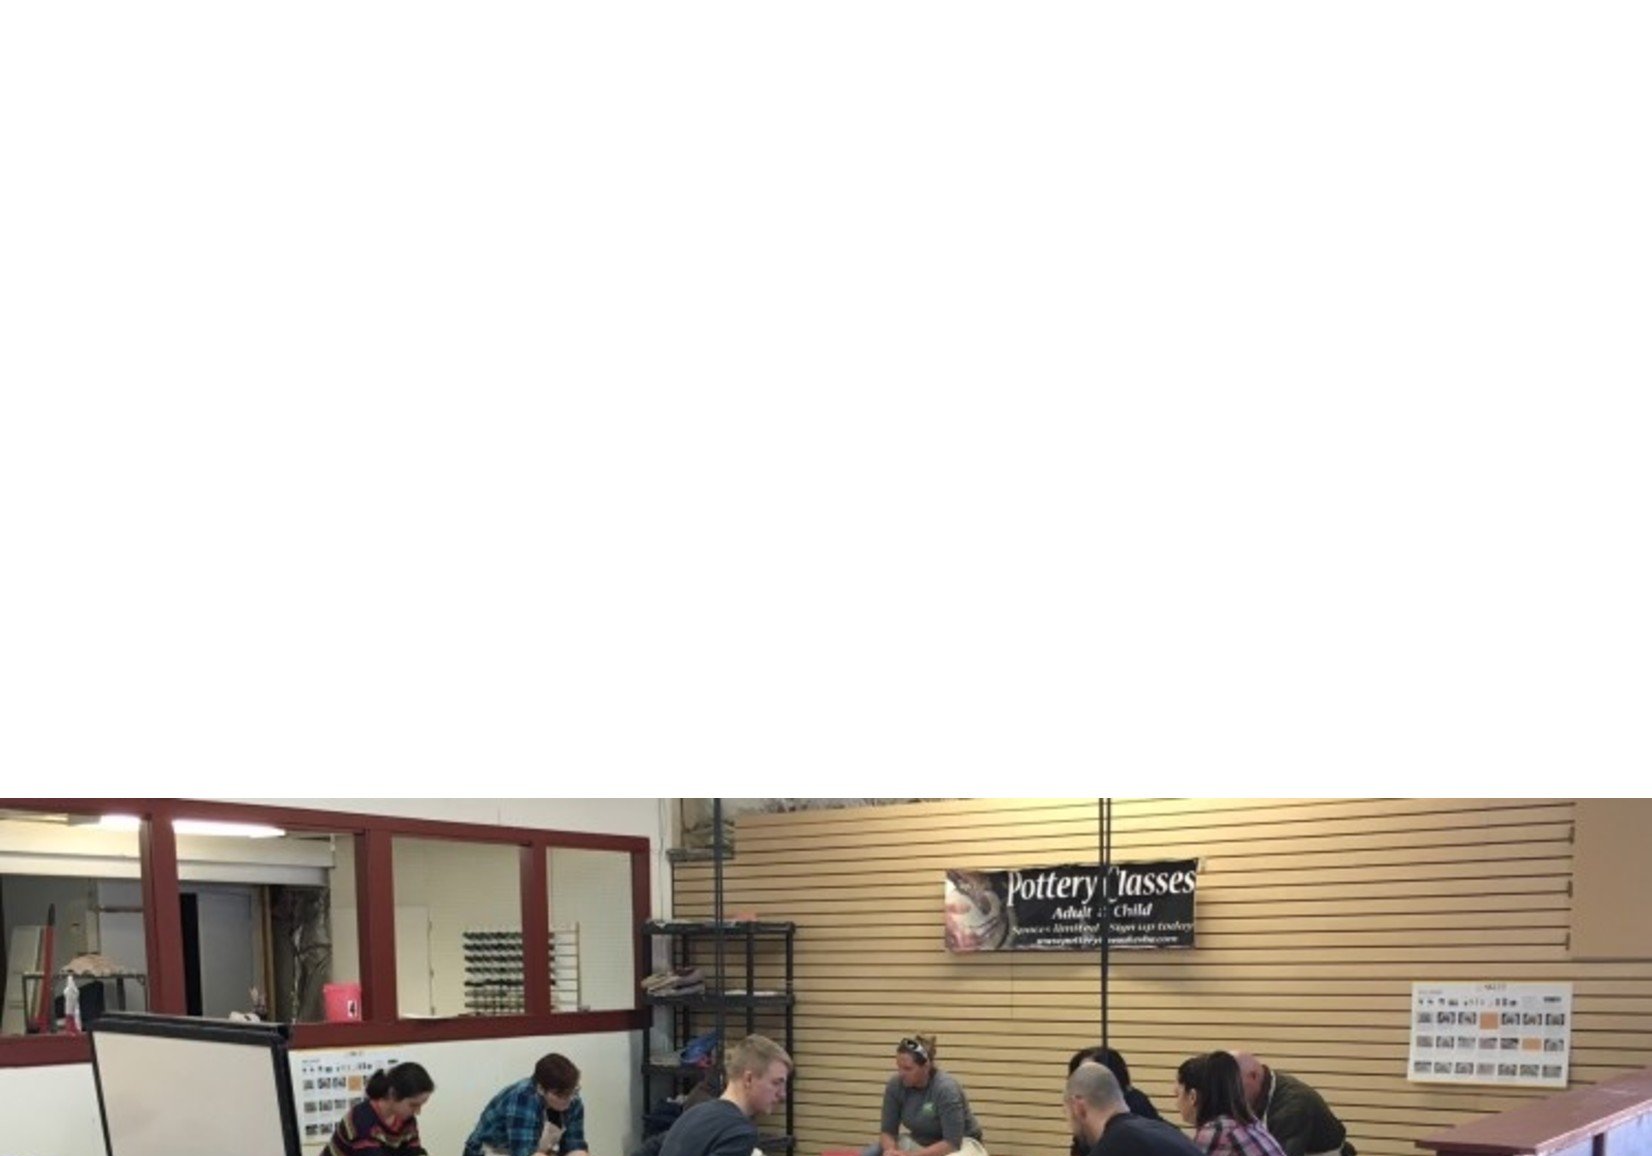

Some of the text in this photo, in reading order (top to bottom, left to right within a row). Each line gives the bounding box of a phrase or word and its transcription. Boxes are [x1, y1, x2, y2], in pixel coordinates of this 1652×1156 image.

[1006, 870, 1098, 907] Pottery
[1050, 905, 1092, 920] Adult
[1113, 902, 1153, 917] Child
